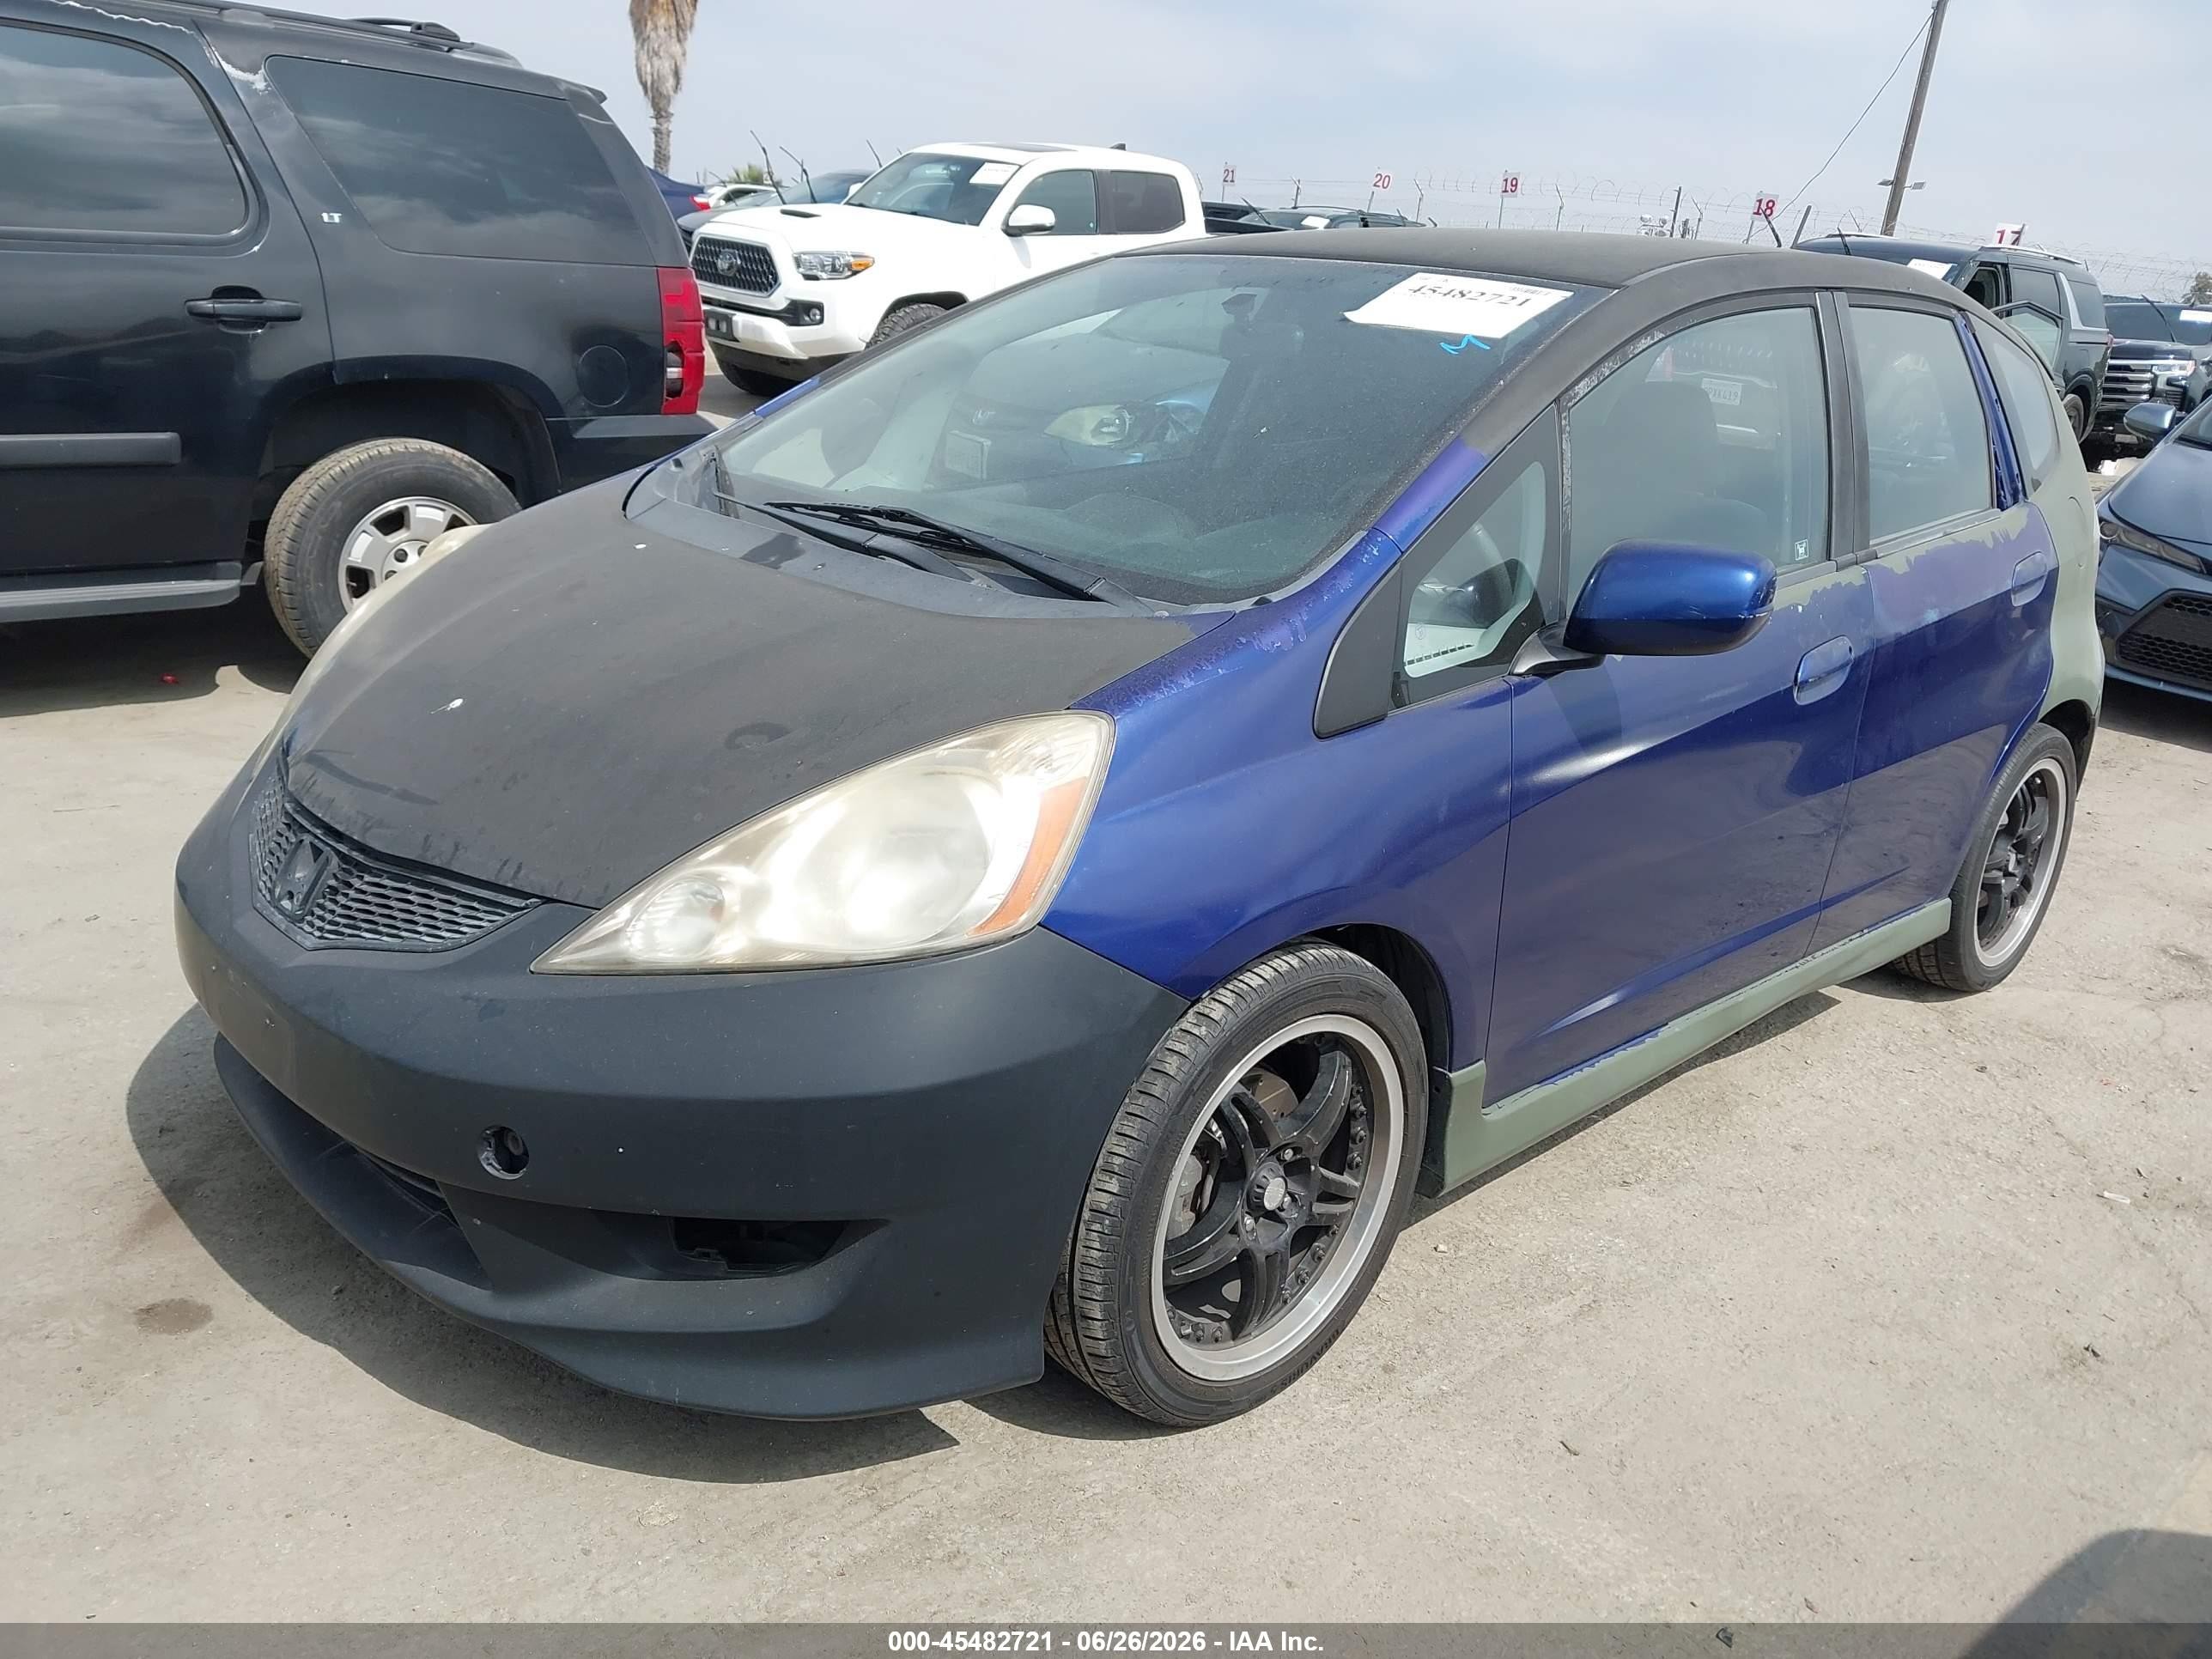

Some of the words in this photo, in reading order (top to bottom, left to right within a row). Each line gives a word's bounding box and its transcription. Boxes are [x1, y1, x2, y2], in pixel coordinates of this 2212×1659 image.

[1223, 168, 1235, 183] 21
[1373, 173, 1391, 189] 20
[1502, 177, 1518, 193] 19
[1753, 198, 1775, 216] 18
[321, 212, 342, 223] LT
[1996, 228, 2021, 246] 17
[1407, 285, 1532, 307] 45482721
